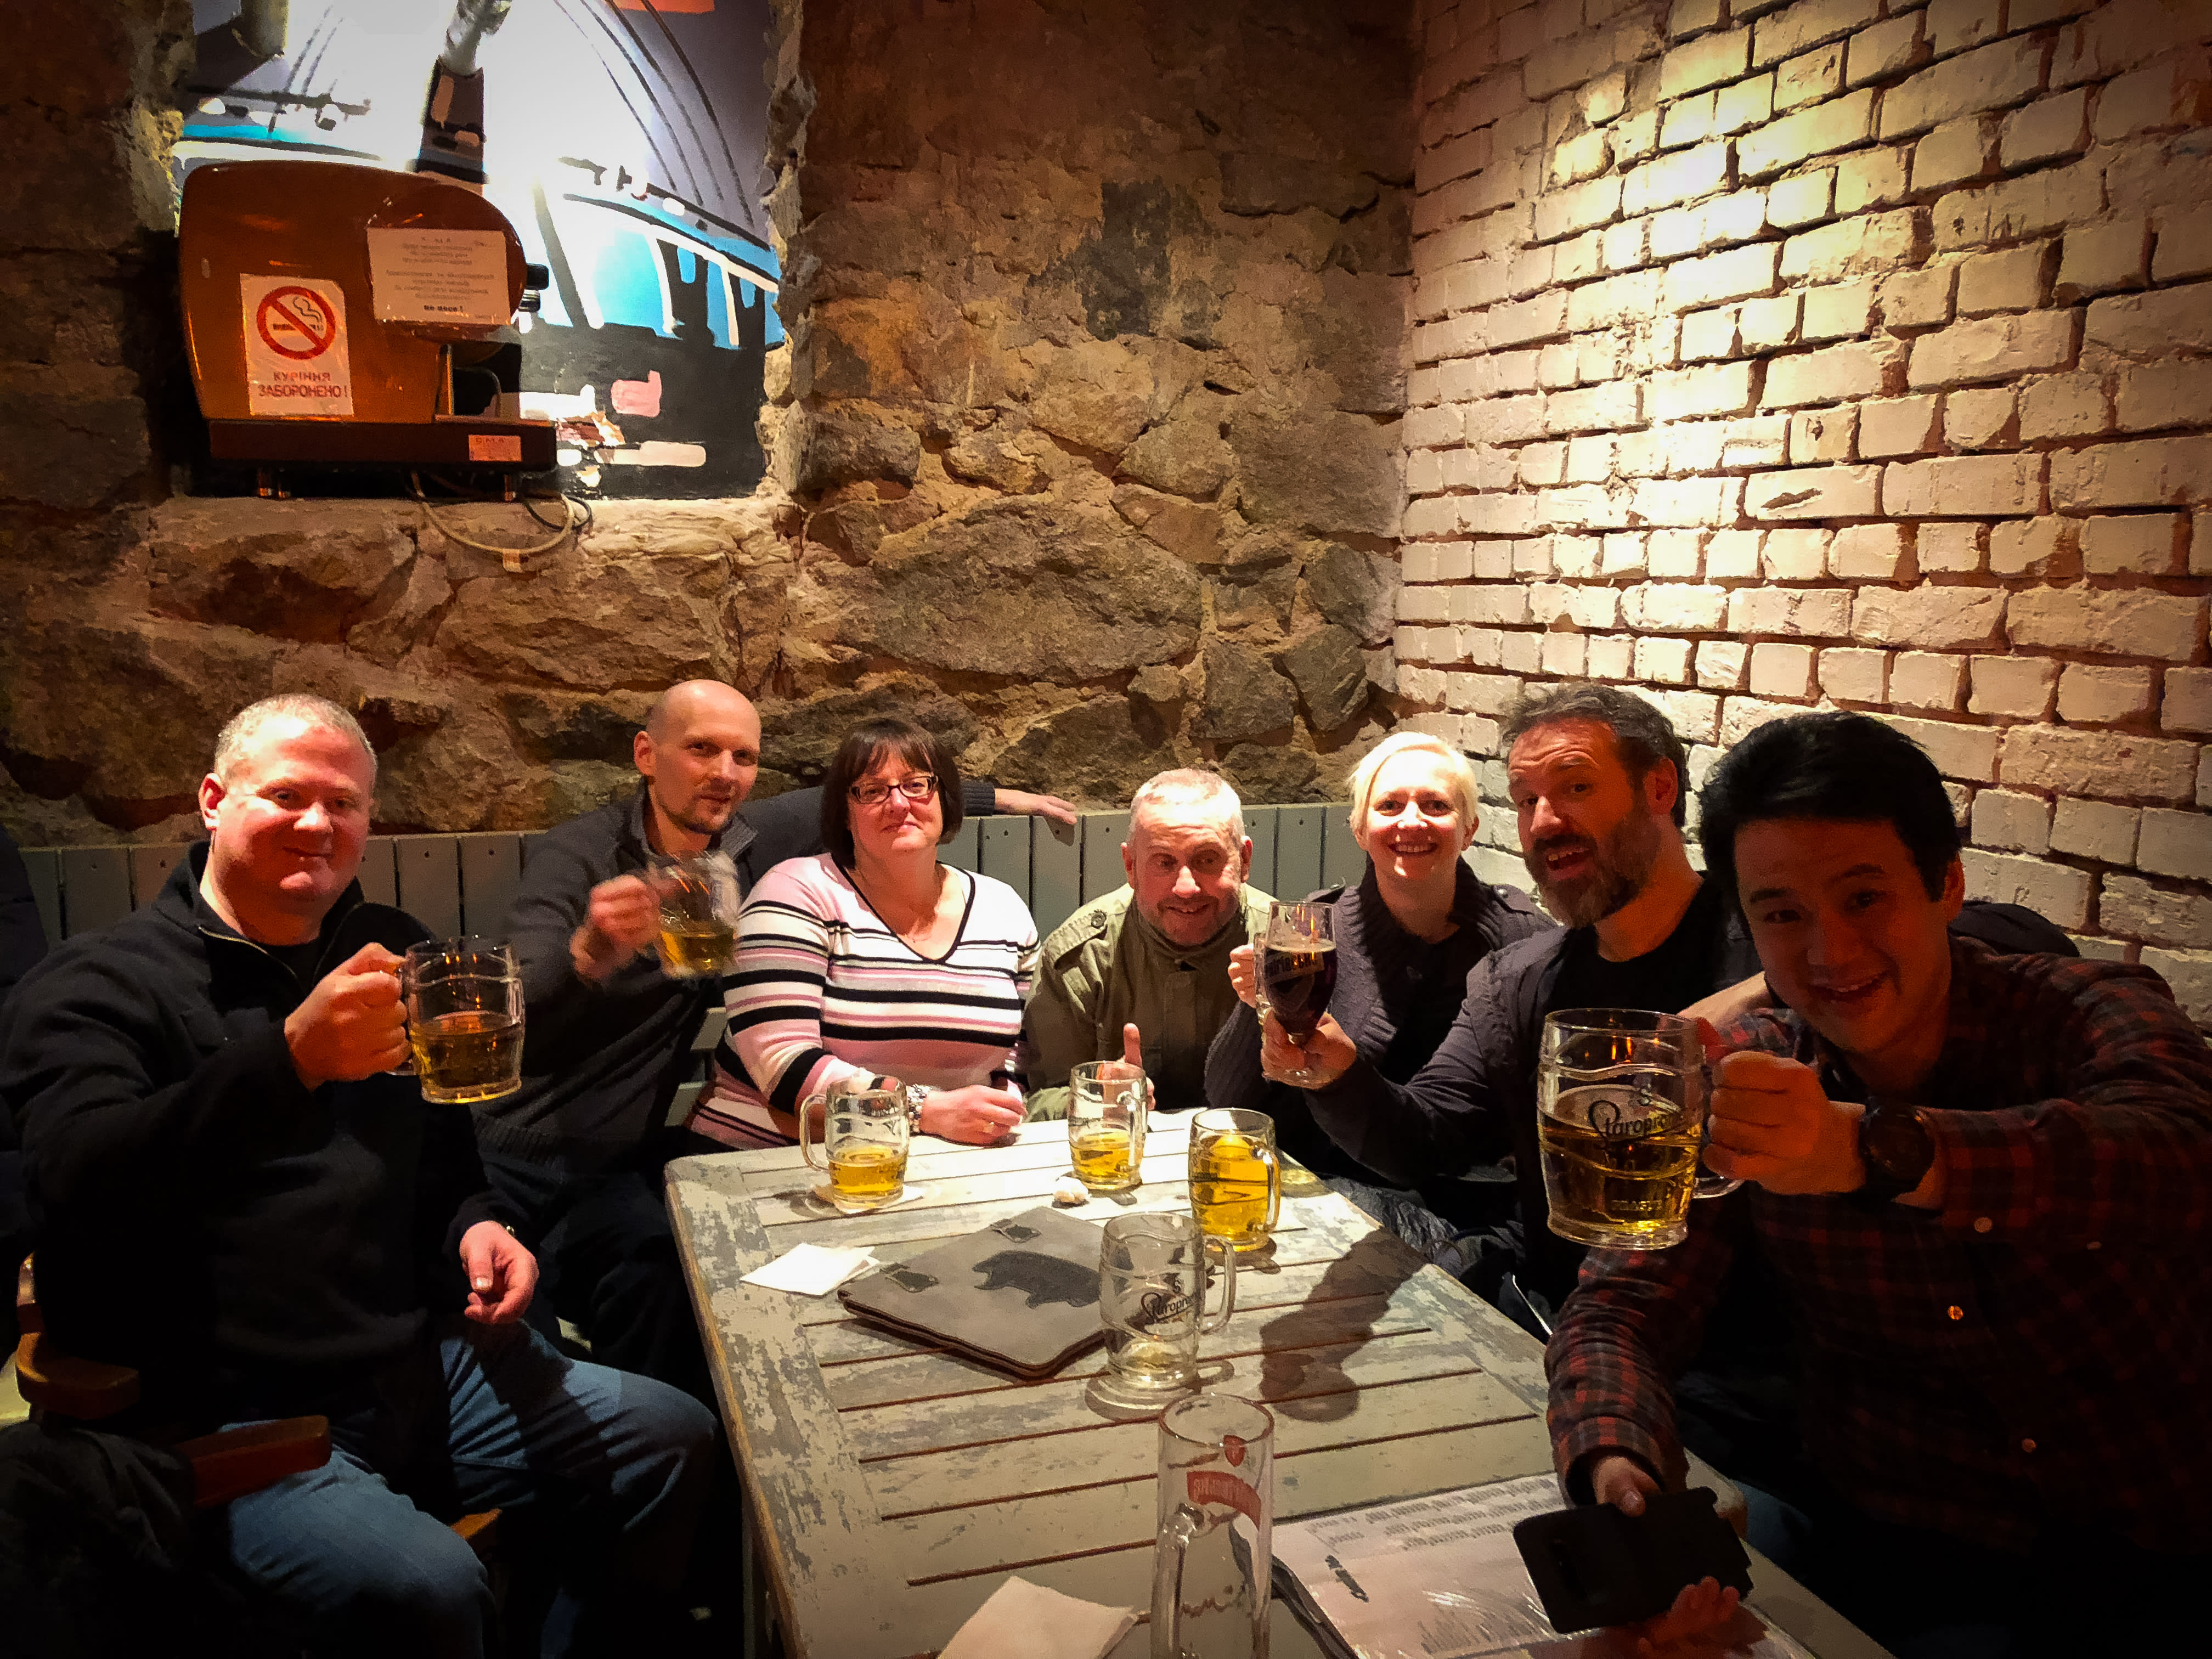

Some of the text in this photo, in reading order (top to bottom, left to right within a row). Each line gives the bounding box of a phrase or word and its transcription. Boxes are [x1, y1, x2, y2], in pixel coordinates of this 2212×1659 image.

[273, 371, 331, 382] КУРІННЯ
[1588, 1099, 1680, 1144] Staropra
[1140, 1291, 1203, 1323] Staropr
